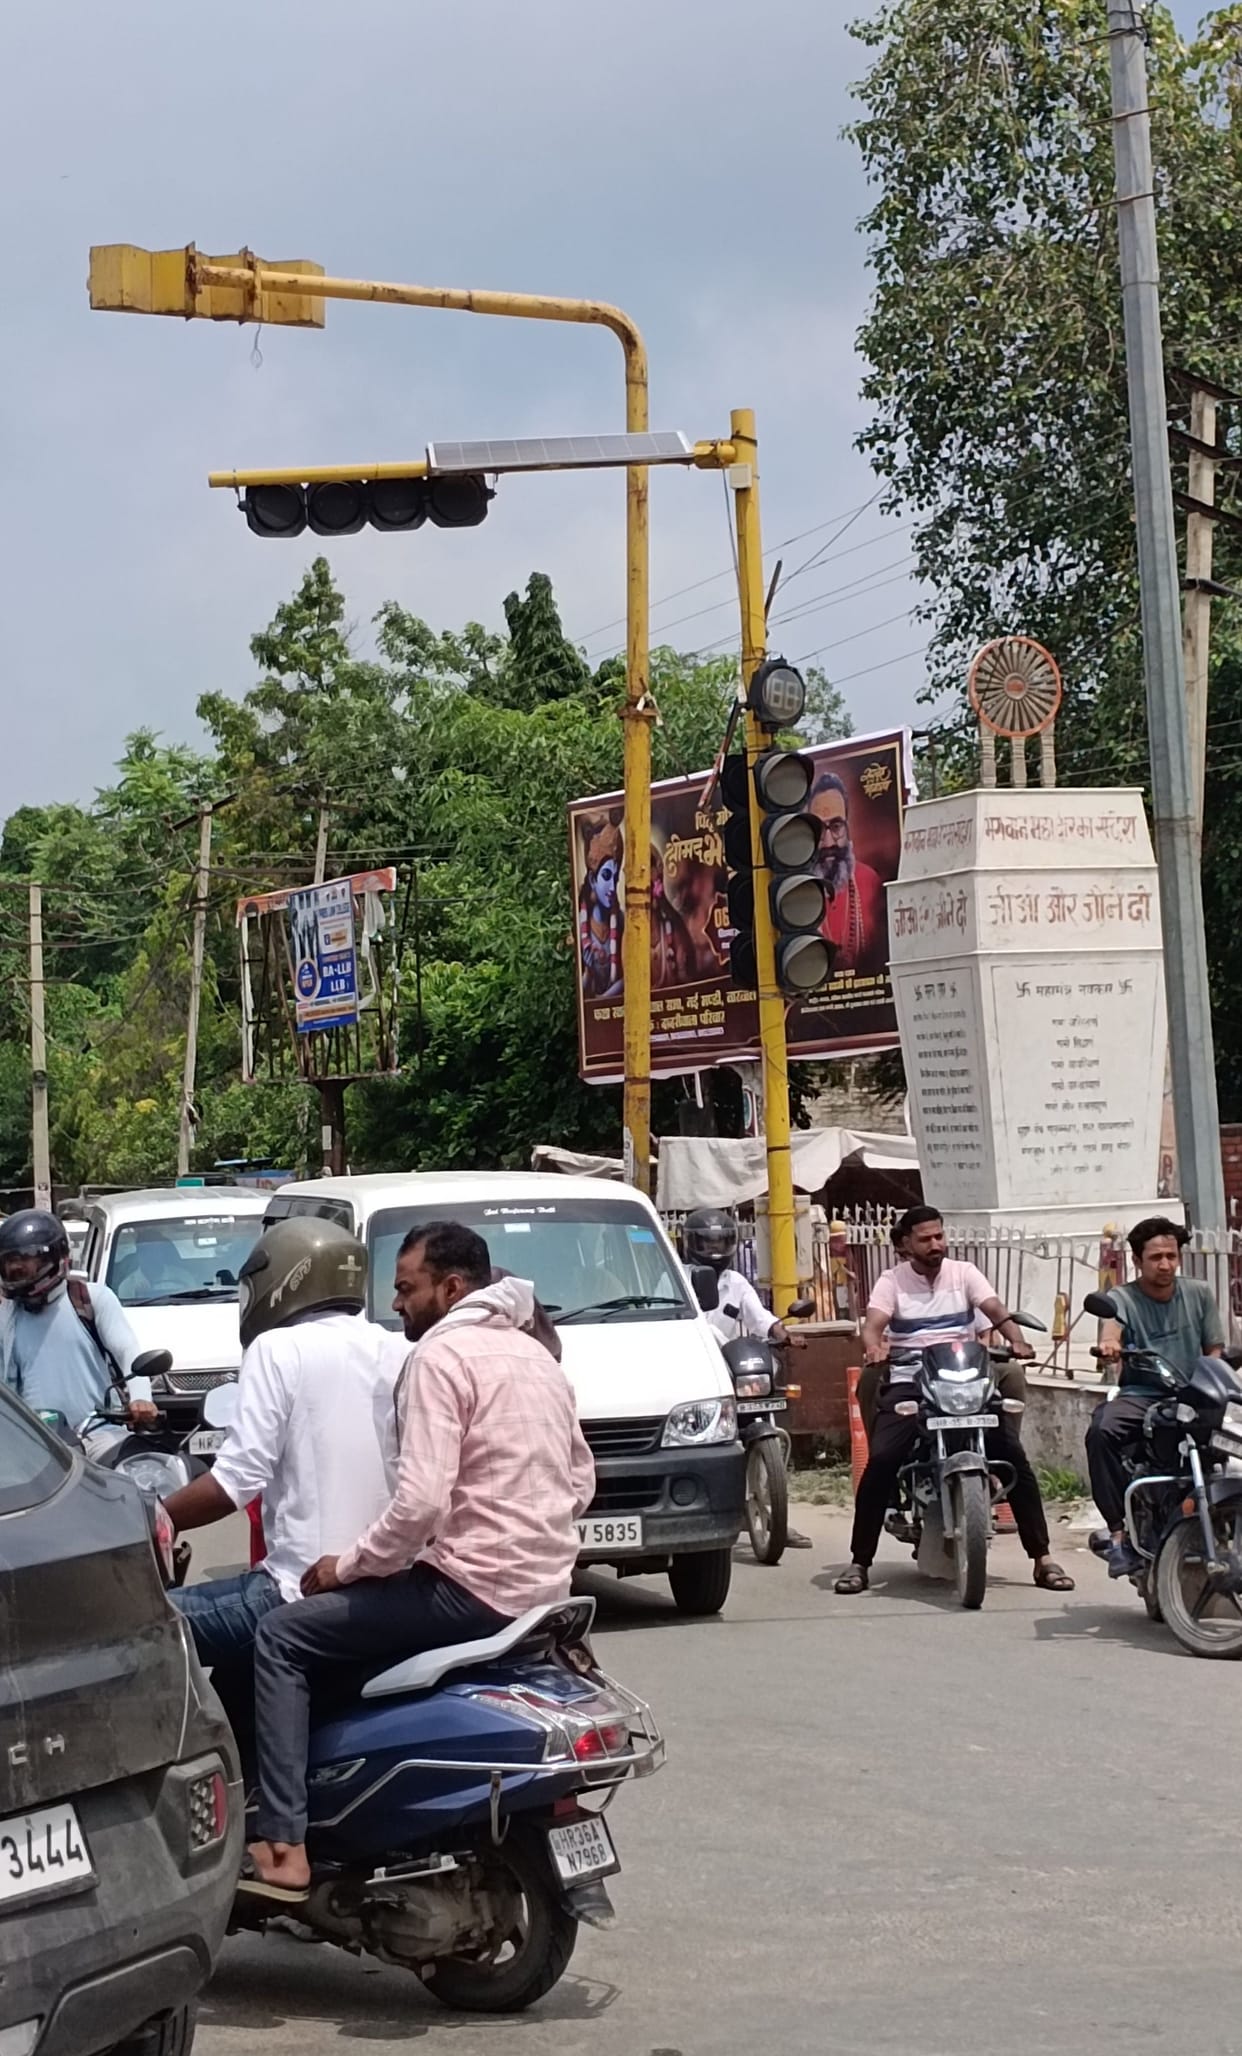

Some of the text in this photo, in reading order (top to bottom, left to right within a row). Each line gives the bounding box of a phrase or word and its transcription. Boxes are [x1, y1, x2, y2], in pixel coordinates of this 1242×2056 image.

[593, 1522, 637, 1543] 5835
[1, 1818, 84, 1879] 3444
[558, 1821, 600, 1850] HR36A
[566, 1842, 607, 1873] N7968
